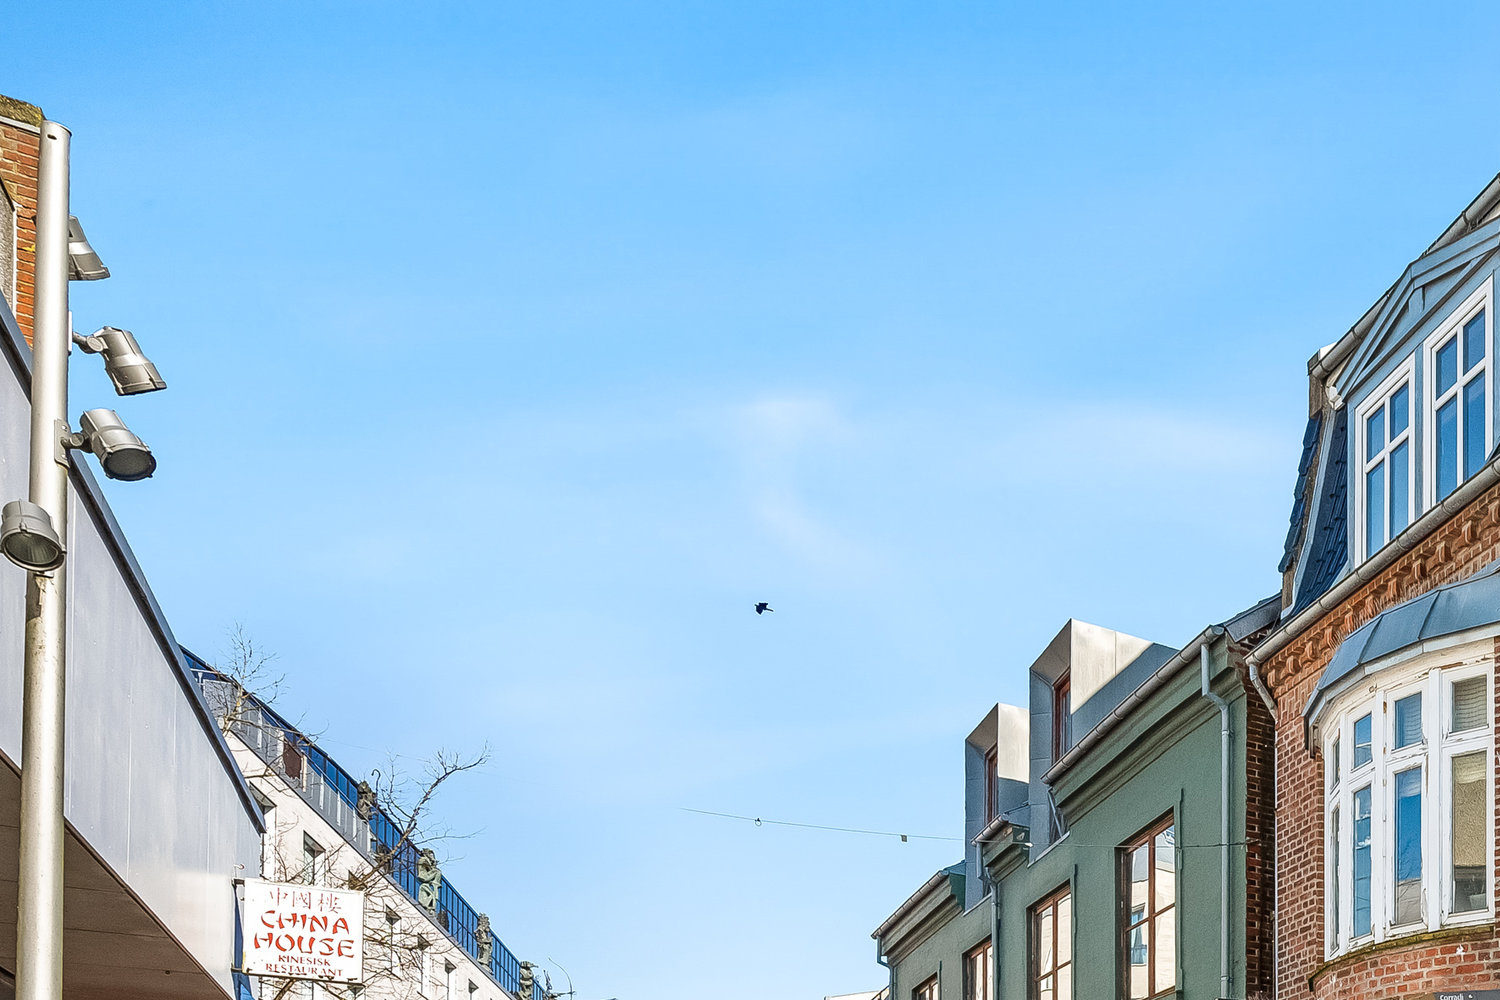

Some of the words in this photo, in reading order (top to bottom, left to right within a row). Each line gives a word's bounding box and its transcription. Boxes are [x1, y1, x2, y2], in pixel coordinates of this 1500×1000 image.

[260, 910, 350, 935] CHINA
[253, 932, 355, 958] HOUSE
[265, 963, 344, 977] RESTAURANT
[278, 954, 331, 967] KINESISK
